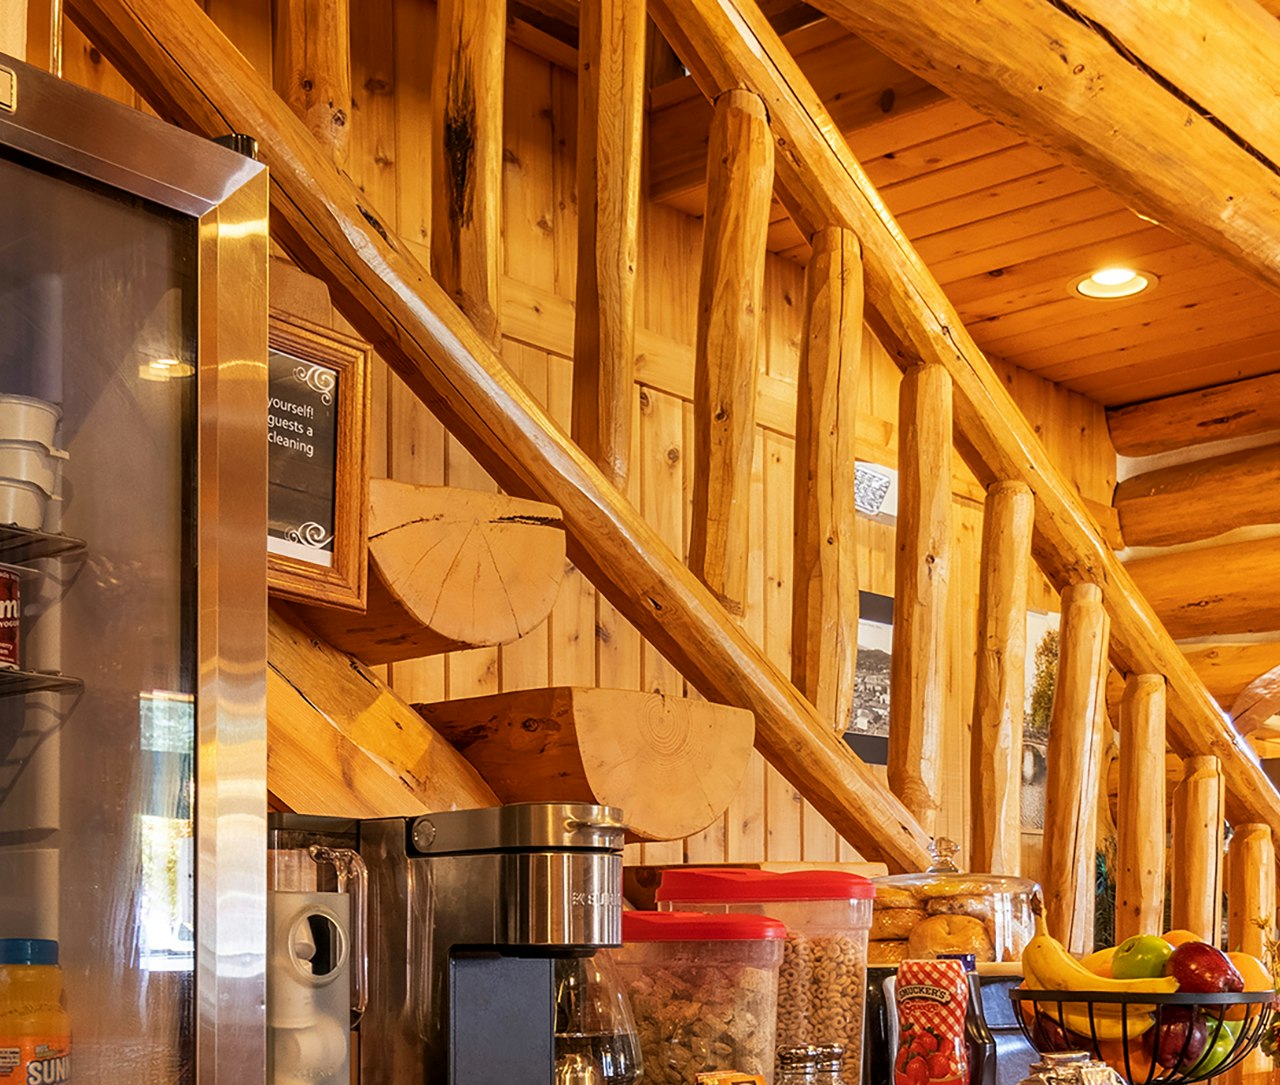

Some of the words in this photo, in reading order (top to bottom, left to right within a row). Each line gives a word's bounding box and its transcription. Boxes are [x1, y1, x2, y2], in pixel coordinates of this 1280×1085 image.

[267, 398, 315, 420] yourself!
[267, 413, 304, 434] guests
[306, 425, 314, 437] a
[267, 431, 315, 457] cleaning
